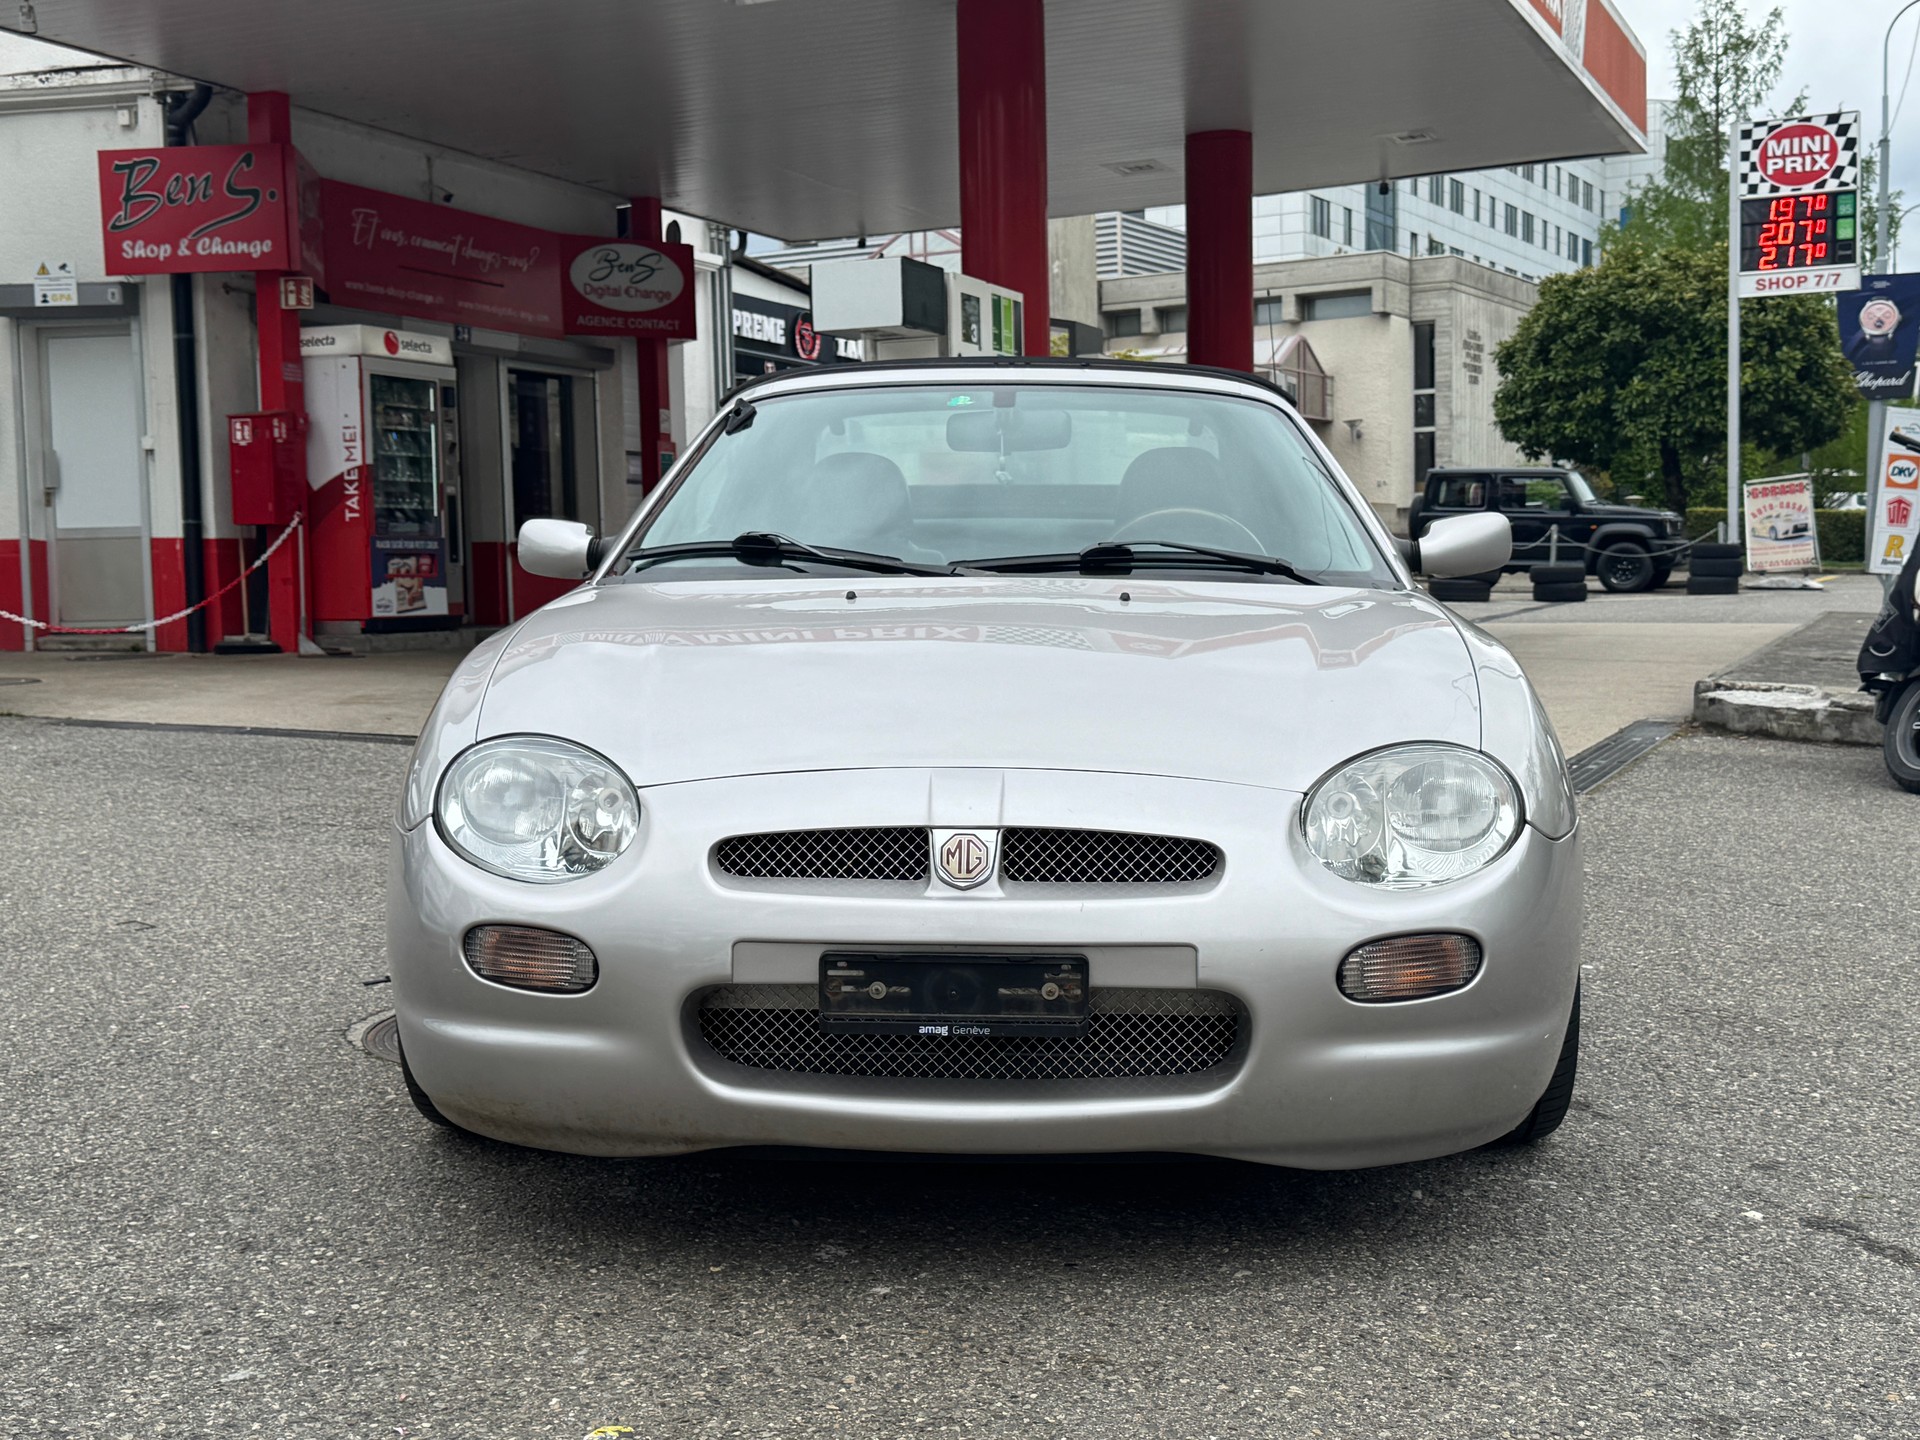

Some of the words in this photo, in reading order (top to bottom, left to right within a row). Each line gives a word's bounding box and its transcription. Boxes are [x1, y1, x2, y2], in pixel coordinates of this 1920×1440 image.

[1766, 134, 1831, 157] MINI
[1766, 153, 1831, 176] PRIX
[108, 157, 213, 232] Ben
[122, 240, 172, 261] Shop
[177, 239, 192, 256] &
[196, 236, 273, 258] Change
[584, 283, 620, 299] Digital
[1755, 275, 1808, 291] SHOP
[1814, 273, 1841, 287] 7/7
[576, 315, 624, 328] AGENCE
[627, 318, 680, 331] CONTACT
[300, 336, 336, 348] selecta
[400, 339, 433, 353] selecta
[343, 424, 358, 462] ME!
[1890, 465, 1916, 478] DKV
[344, 467, 360, 521] TAKE
[1884, 534, 1905, 558] R
[946, 839, 983, 875] MG
[918, 1025, 949, 1036] amag
[952, 1025, 991, 1036] Genève
